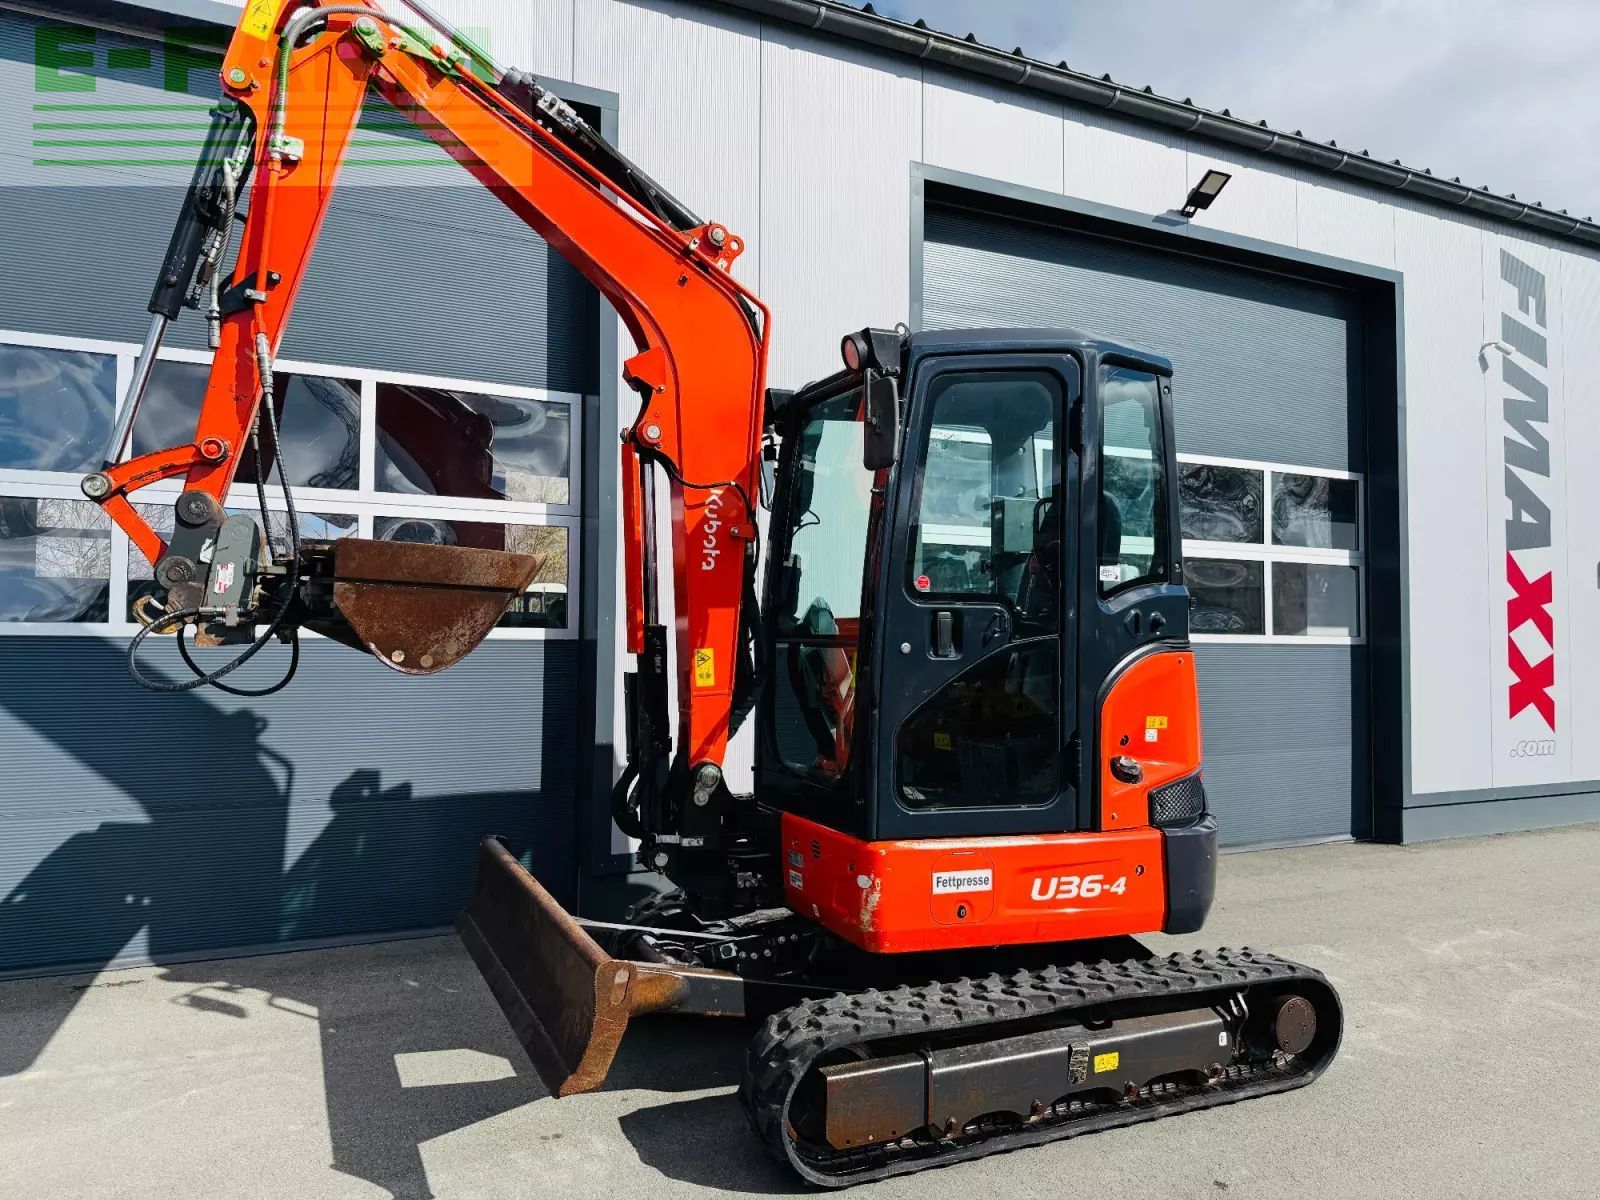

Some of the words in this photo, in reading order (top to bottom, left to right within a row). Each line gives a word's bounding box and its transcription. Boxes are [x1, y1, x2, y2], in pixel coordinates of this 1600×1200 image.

[1499, 247, 1555, 733] FIMAXX
[702, 488, 724, 571] Kubota
[1509, 739, 1556, 758] .com
[936, 875, 990, 890] Fettpresse
[1031, 874, 1127, 901] U36-4
